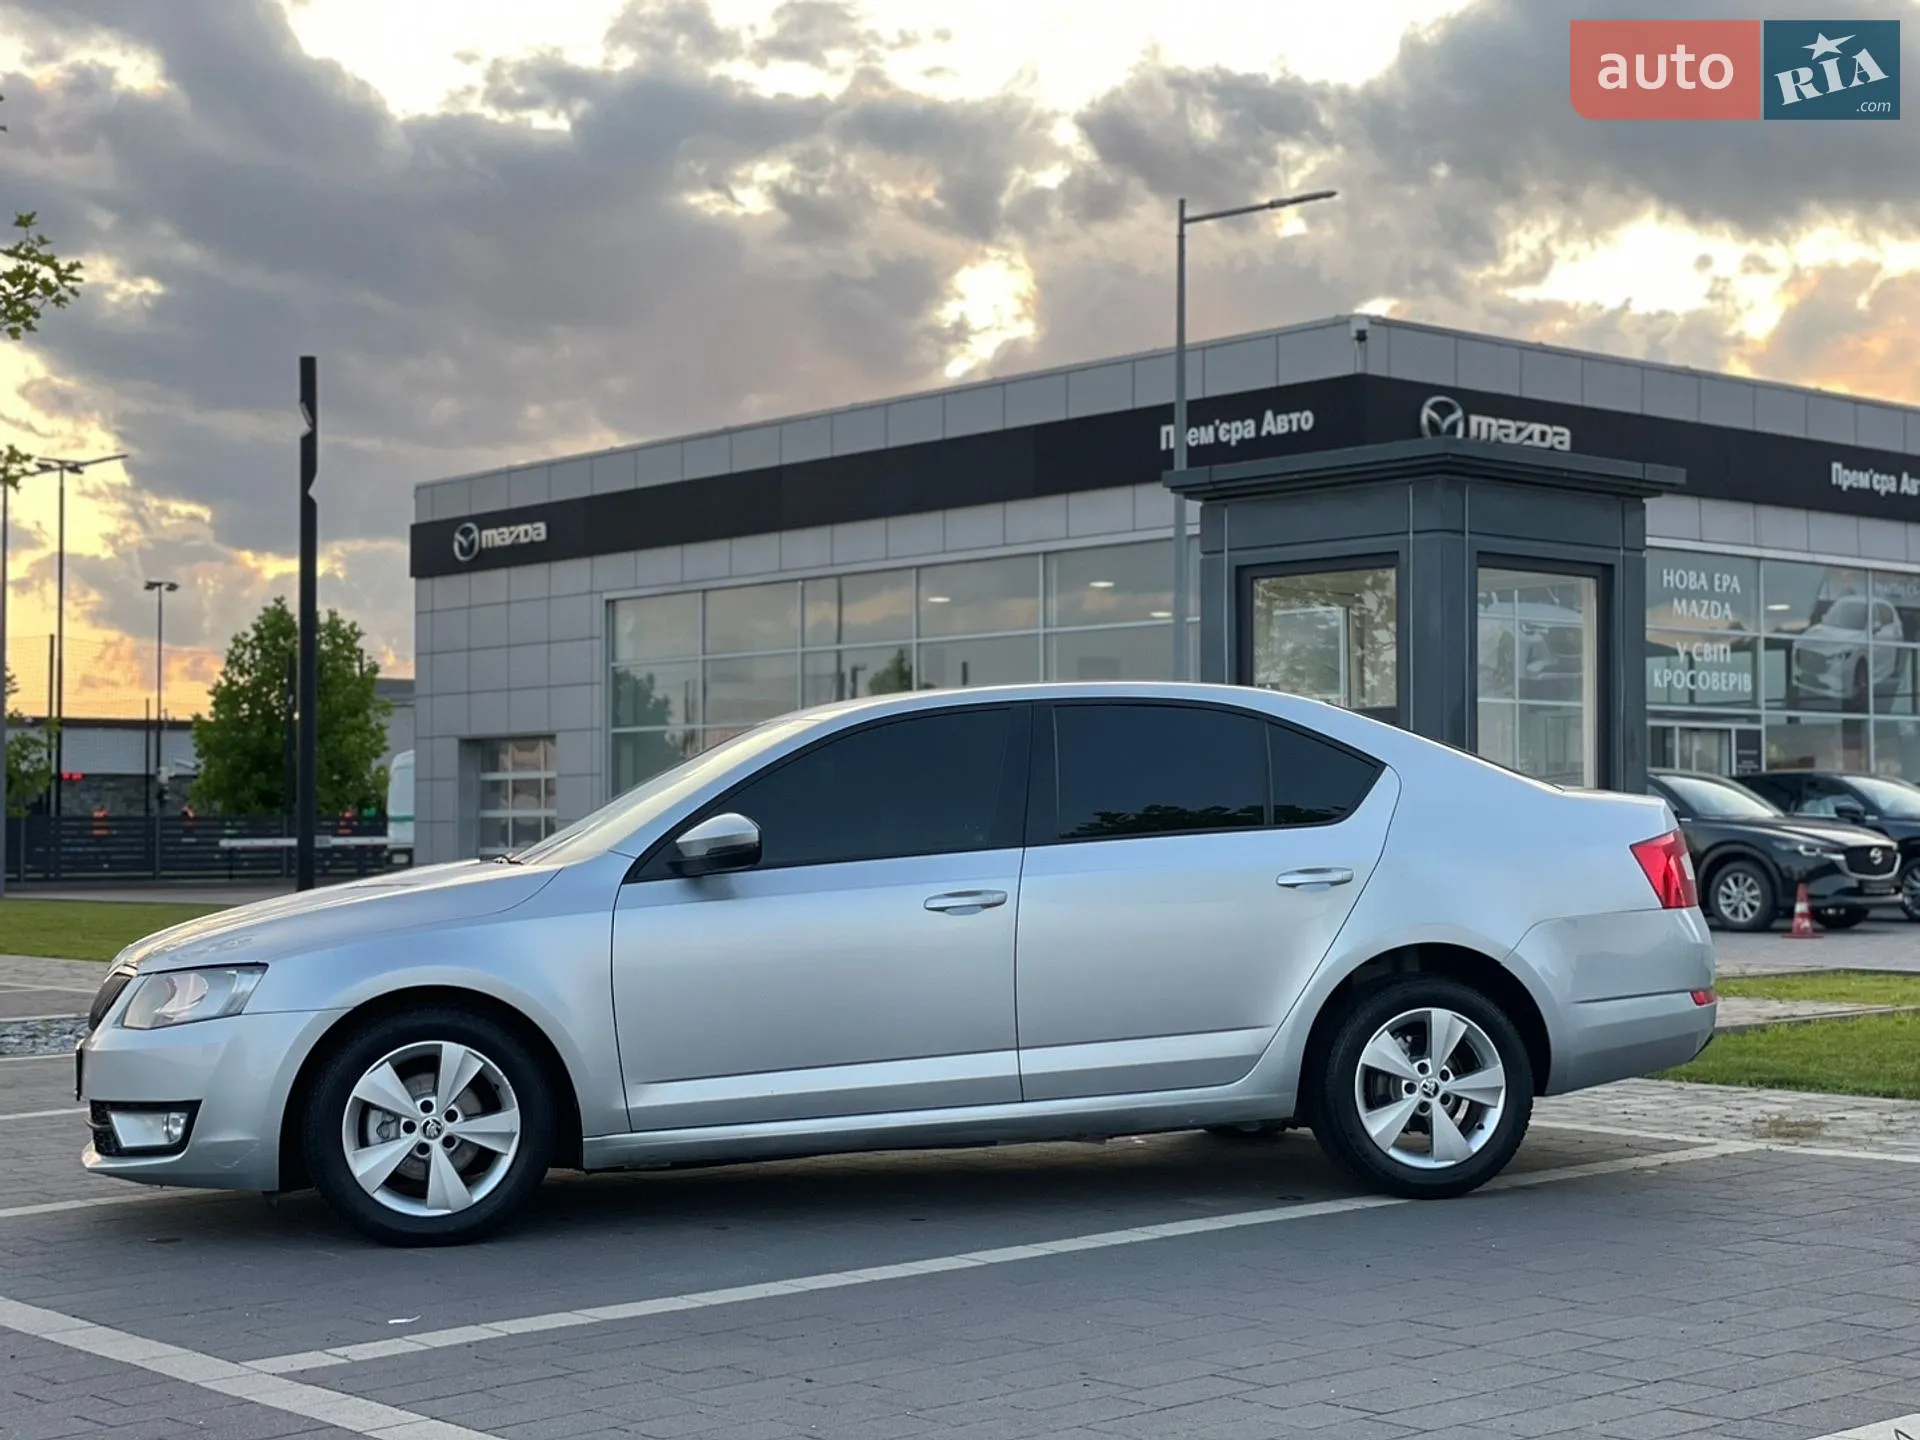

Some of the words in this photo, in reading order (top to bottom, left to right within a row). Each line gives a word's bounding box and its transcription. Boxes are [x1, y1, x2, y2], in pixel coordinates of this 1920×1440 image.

[1160, 416, 1255, 450] Пем'єра
[1260, 408, 1315, 437] Авто
[1662, 568, 1709, 592] НОВА
[1714, 574, 1741, 594] ЕРА
[1672, 598, 1733, 620] MAZDA
[1676, 641, 1690, 662] У
[1654, 668, 1752, 692] КРОСОВЕРІВ
